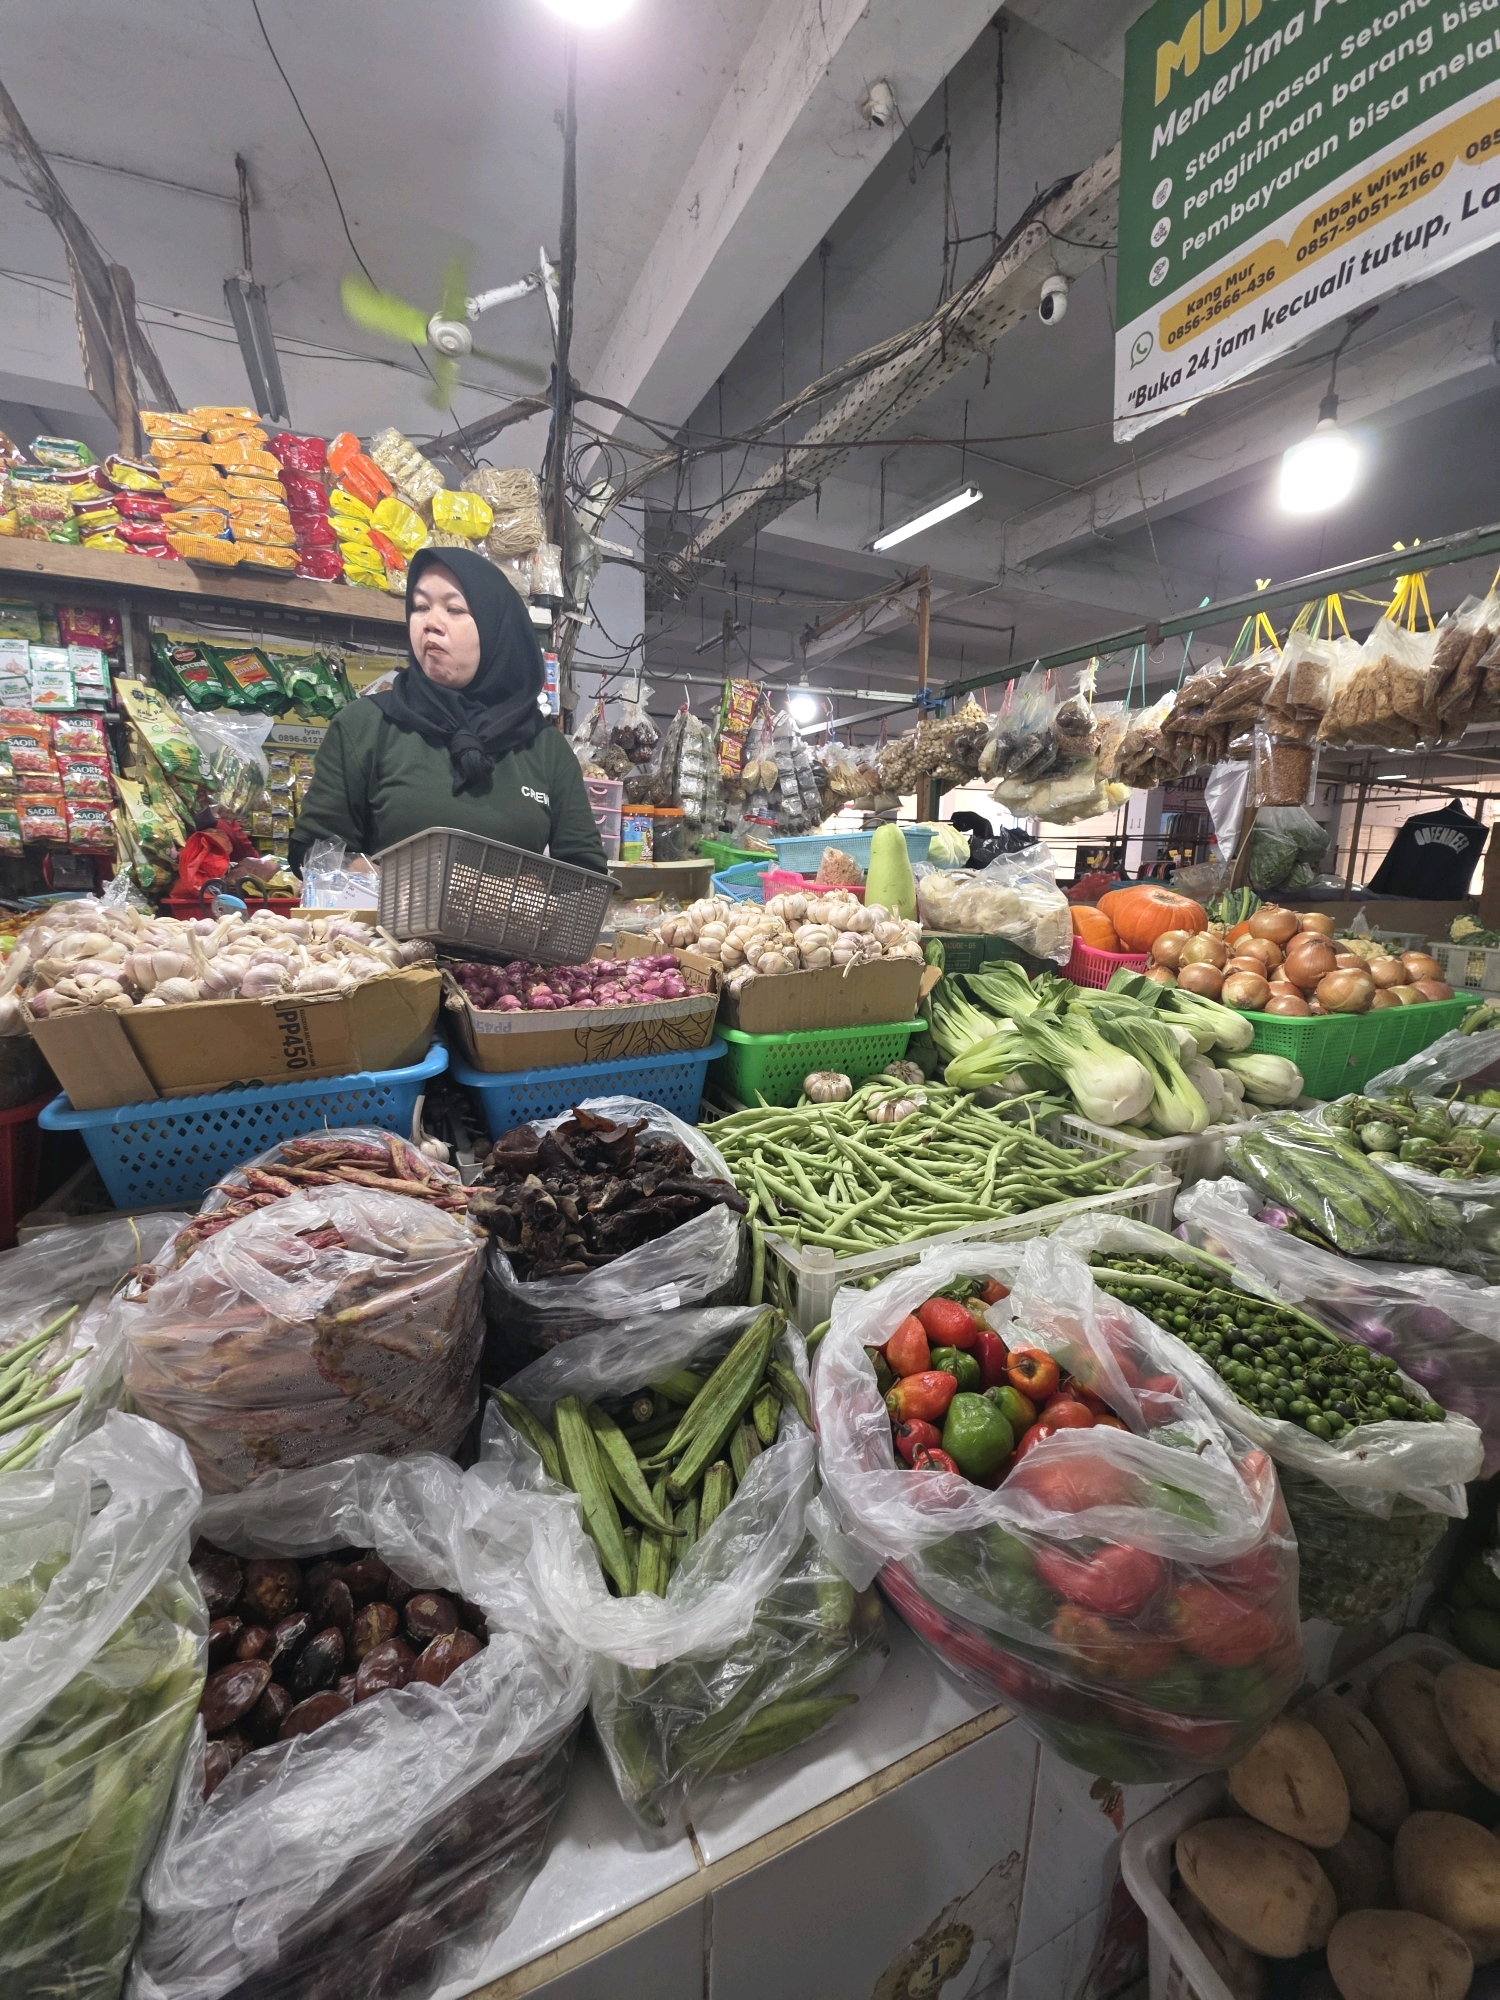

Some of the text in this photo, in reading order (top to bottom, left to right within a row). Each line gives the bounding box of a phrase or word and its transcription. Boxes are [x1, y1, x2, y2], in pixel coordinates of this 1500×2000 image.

[1150, 10, 1305, 162] Menerima
[1183, 101, 1323, 220] Pengiriman
[1332, 26, 1434, 107] barang
[1185, 111, 1252, 182] stand
[1259, 53, 1333, 130] pasar
[1182, 134, 1339, 261] Pembayaran
[1348, 86, 1409, 141] bisa
[1295, 161, 1446, 262] 0857-9051-2160
[1313, 151, 1428, 234] Mbak Wiwik
[1167, 266, 1276, 345] 0856-3666-436
[1185, 345, 1210, 380] 24
[1211, 323, 1256, 371] jam
[1260, 256, 1357, 336] kecuali
[1359, 214, 1452, 276] tutup,
[1186, 263, 1256, 316] Kang Mur
[7, 738, 37, 747] SAORI
[66, 718, 93, 727] AORI
[27, 807, 56, 816] SAORI
[276, 1010, 309, 1070] PP450
